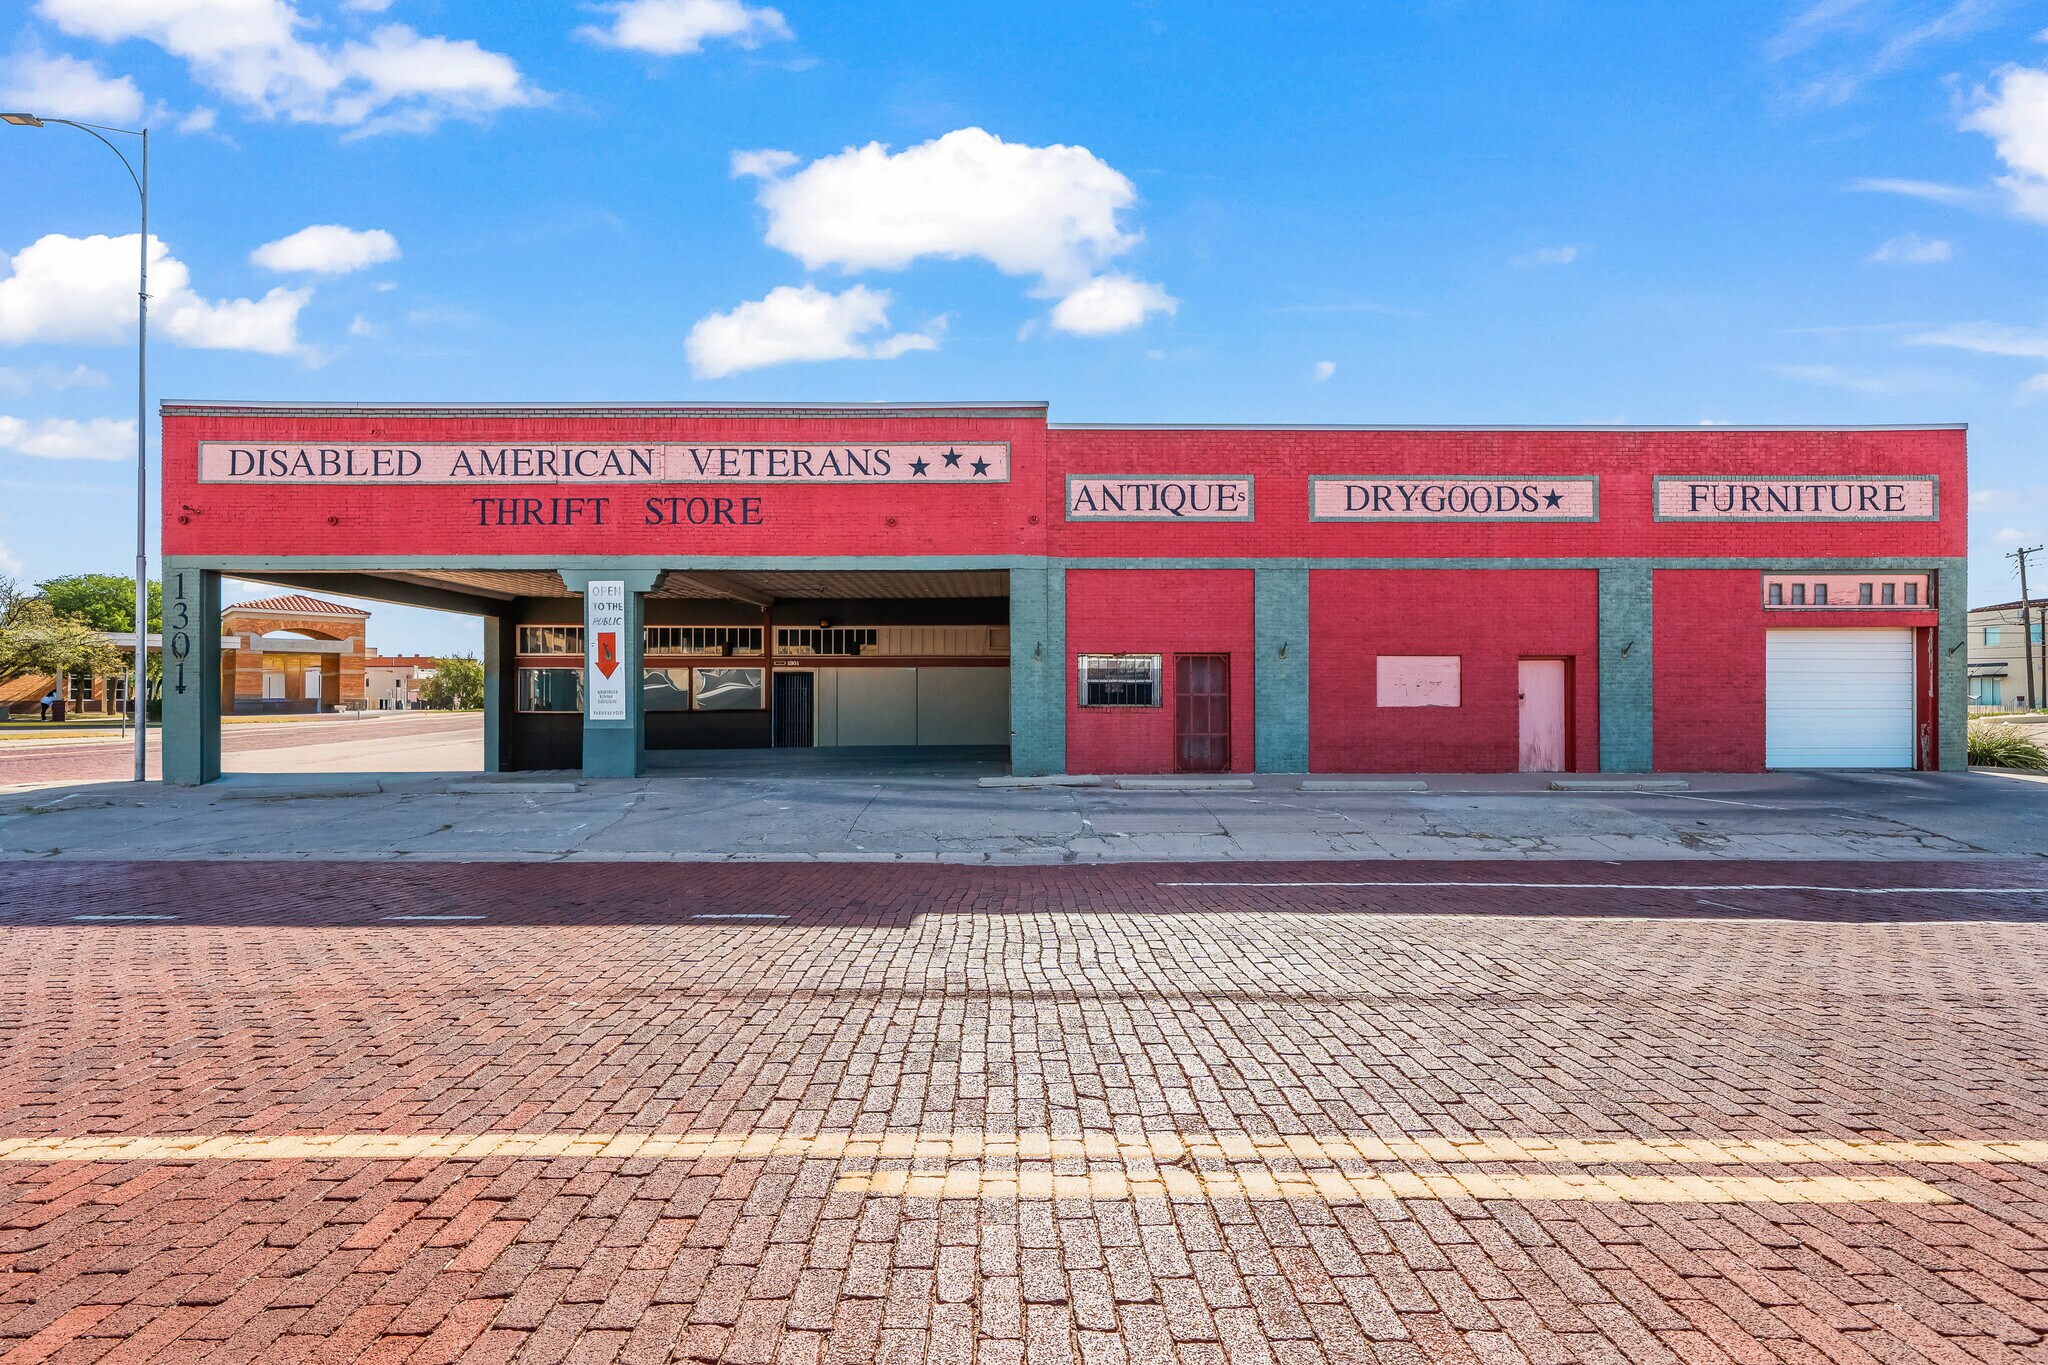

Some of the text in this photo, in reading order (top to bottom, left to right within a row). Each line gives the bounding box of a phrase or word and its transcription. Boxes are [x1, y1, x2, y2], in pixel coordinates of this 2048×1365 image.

[229, 448, 891, 477] DISABLED AMERICAN VETERANS
[472, 497, 764, 526] THRIFT STORE
[1688, 484, 1906, 513] FURNITURE
[592, 586, 621, 596] OPEN
[592, 602, 623, 612] TO THE
[592, 617, 622, 626] PUBLIC
[170, 573, 191, 695] 1301
